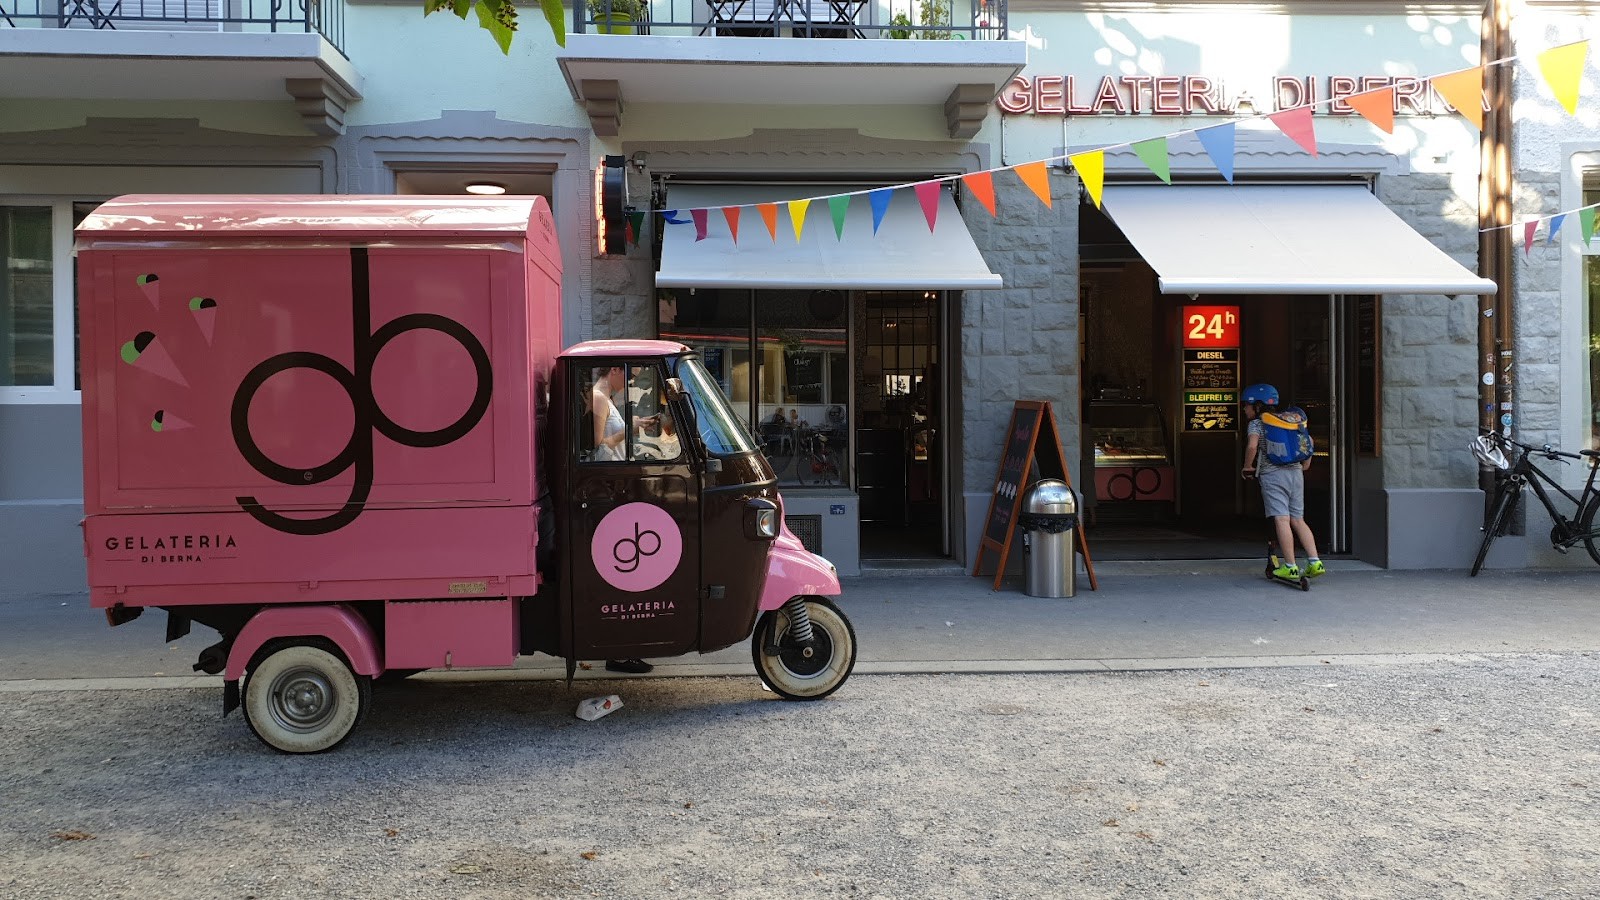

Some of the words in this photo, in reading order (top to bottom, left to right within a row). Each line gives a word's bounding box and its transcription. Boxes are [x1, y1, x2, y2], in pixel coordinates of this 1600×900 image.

[1272, 75, 1317, 114] DI
[1197, 351, 1225, 359] DIESEL
[1189, 394, 1222, 402] BLEIFREI
[105, 535, 237, 550] GELATERIA
[161, 555, 202, 563] BERNA
[601, 601, 675, 614] GELATERIA
